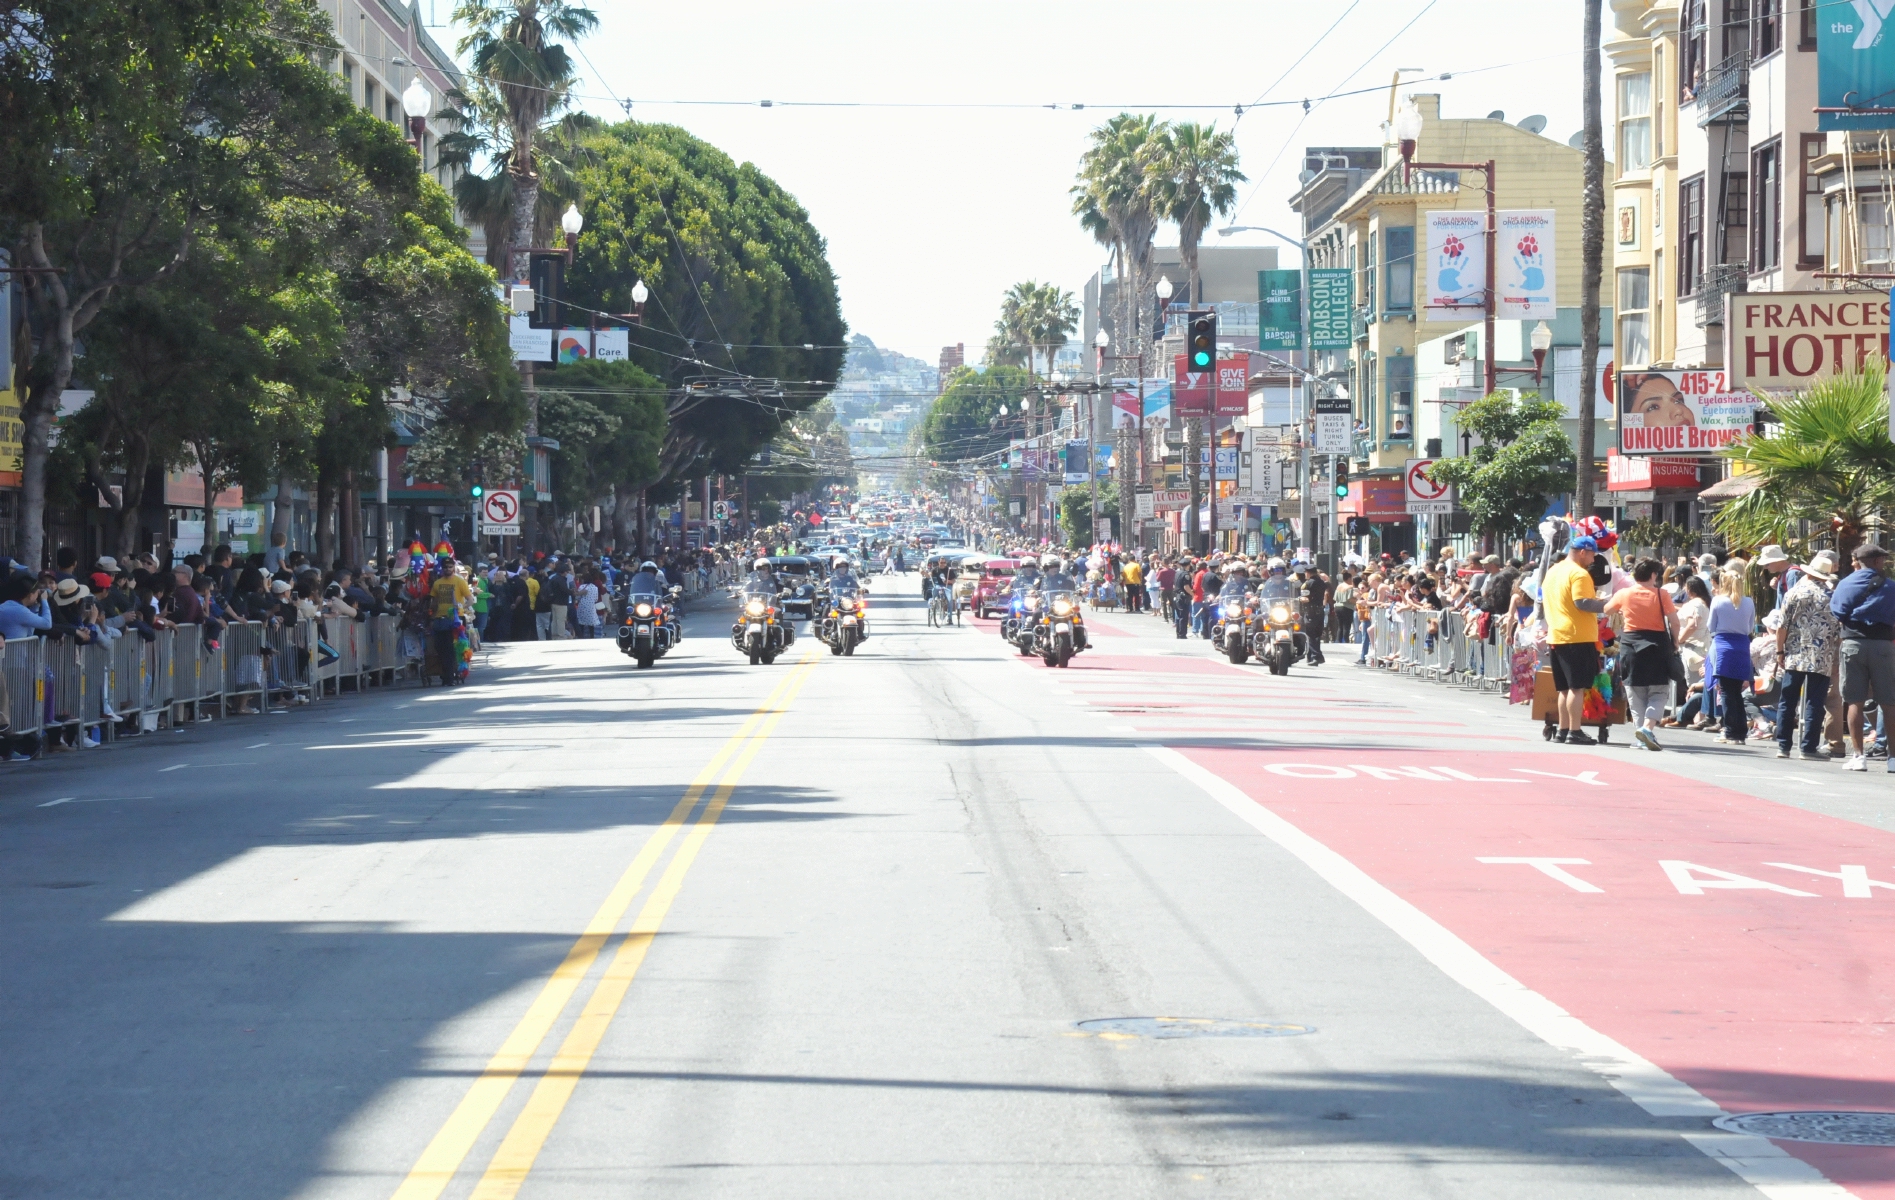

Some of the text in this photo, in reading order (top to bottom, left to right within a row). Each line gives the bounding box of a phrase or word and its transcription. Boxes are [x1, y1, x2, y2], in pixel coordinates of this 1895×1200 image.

[1830, 22, 1854, 34] the
[1872, 33, 1884, 47] YMCA
[1312, 279, 1331, 340] BABSON
[1331, 278, 1349, 339] COLLEGE
[1264, 331, 1296, 340] BABSON
[1281, 339, 1296, 347] MBA
[598, 348, 624, 356] Care.
[1220, 368, 1245, 377] GIVE
[1220, 377, 1245, 387] JOIN
[1698, 395, 1743, 405] Eyelashes
[1702, 406, 1746, 417] Eyebrows
[1700, 416, 1724, 426] Wax,
[1623, 426, 1684, 451] UNIQUE
[1688, 425, 1742, 448] Brows
[1263, 454, 1271, 491] GROCERY
[1652, 465, 1695, 476] INSURANC
[1410, 504, 1431, 512] EXCEPT
[1263, 763, 1610, 786] ONLY
